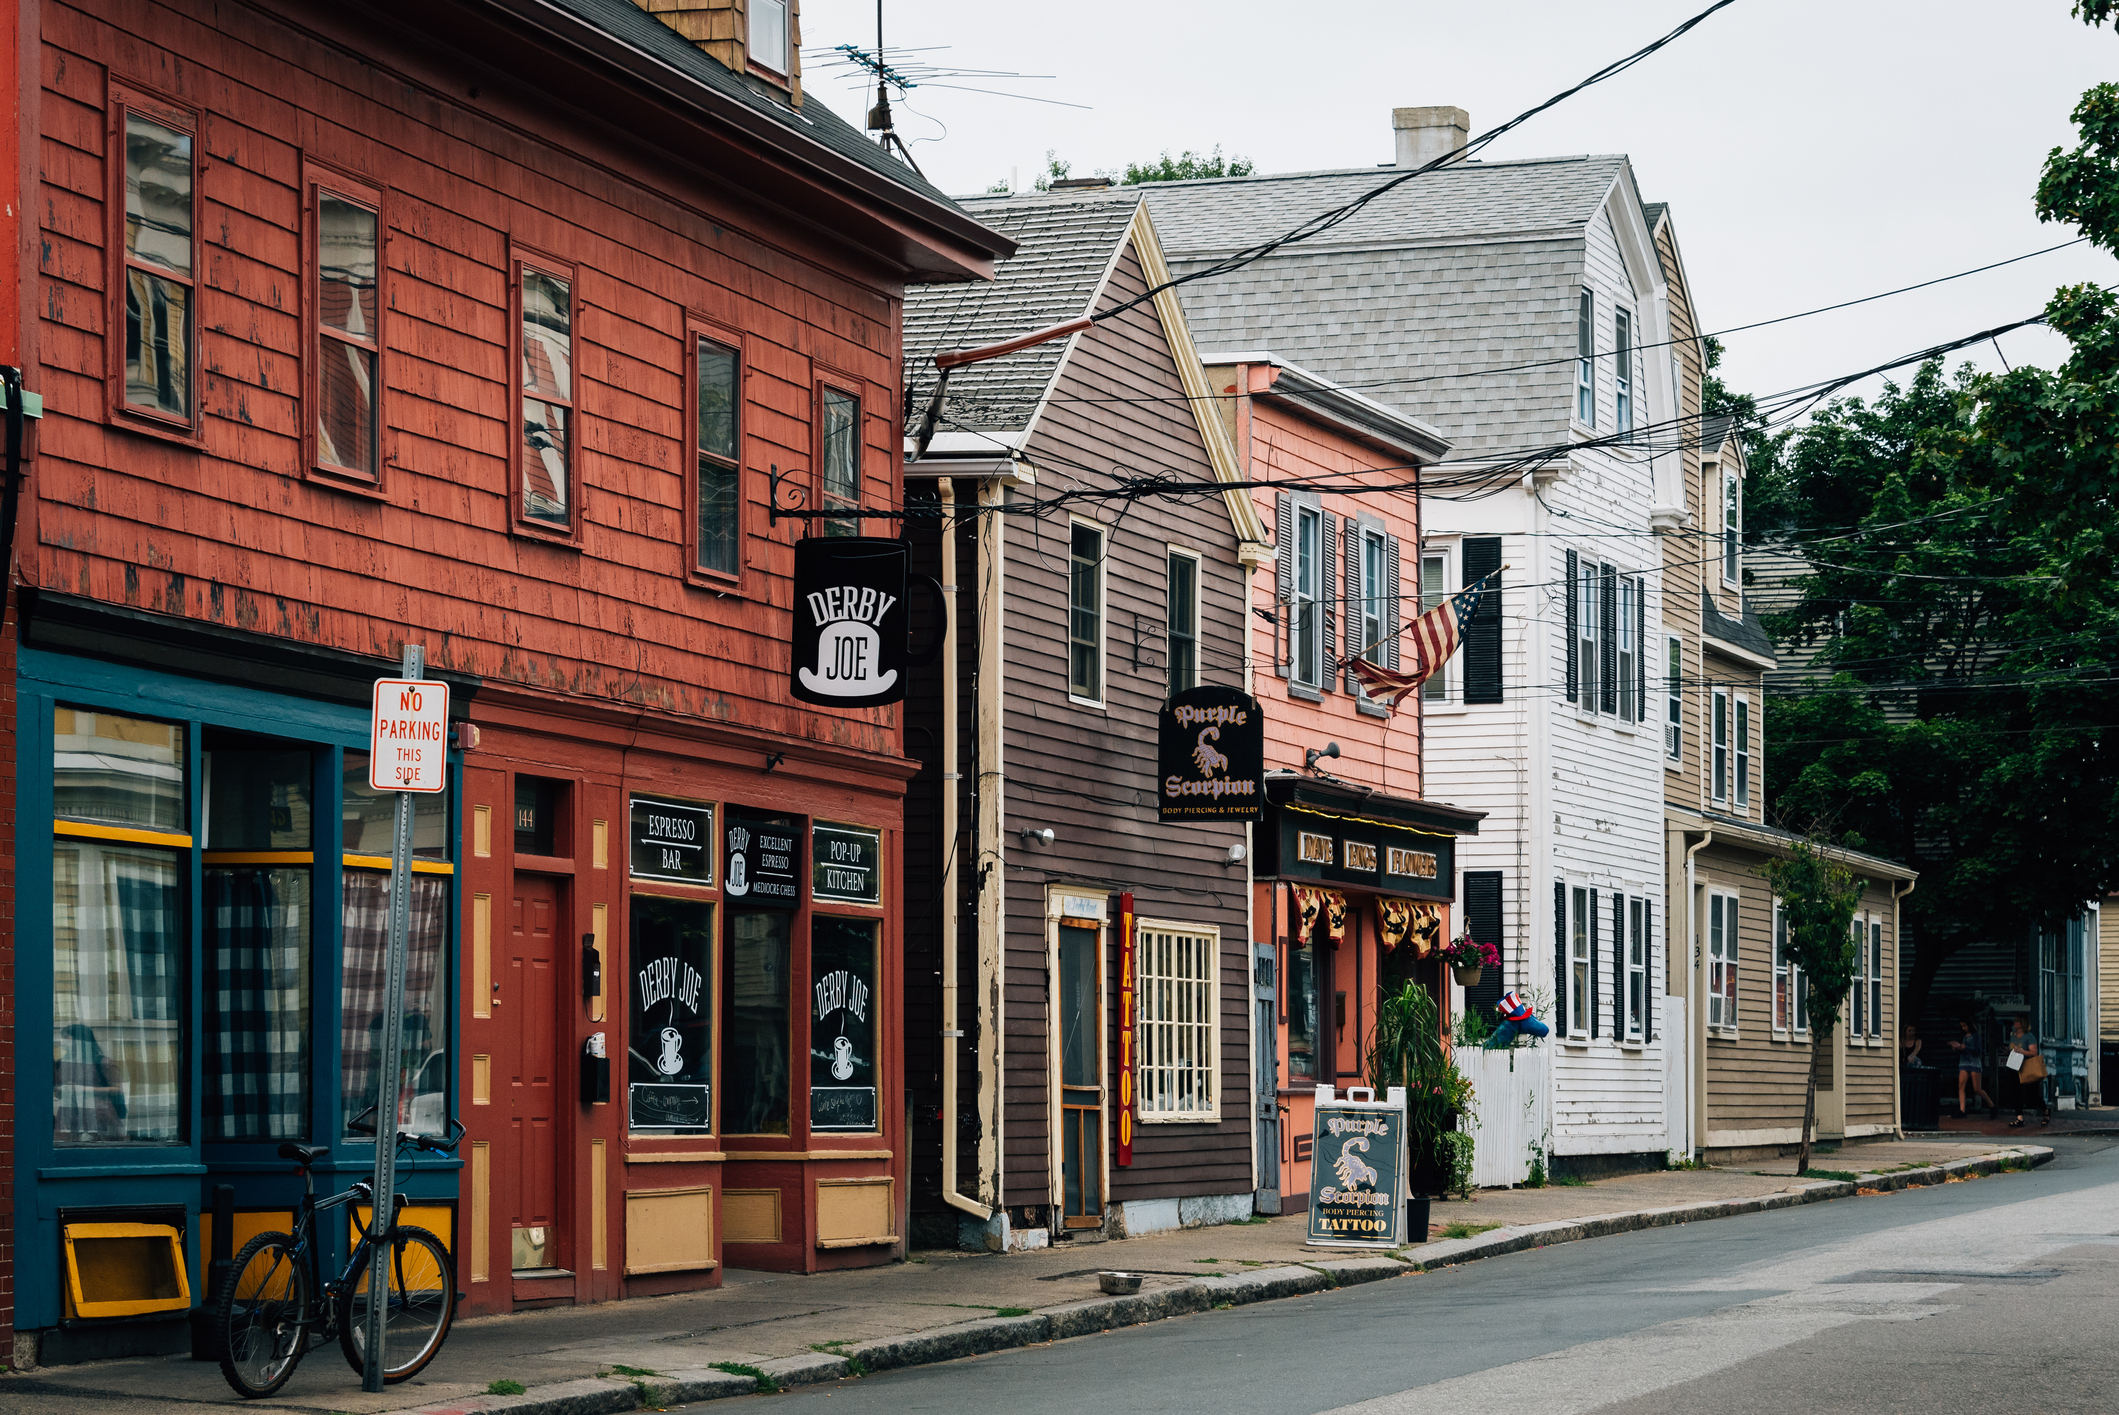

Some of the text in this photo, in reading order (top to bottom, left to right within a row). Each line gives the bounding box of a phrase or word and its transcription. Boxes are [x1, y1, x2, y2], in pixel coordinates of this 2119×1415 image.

[806, 586, 896, 627] DERBY
[826, 636, 868, 680] JOE
[400, 692, 422, 712] NO
[1174, 704, 1247, 729] Purple
[380, 719, 440, 741] PARKING
[397, 748, 422, 762] THIS
[396, 767, 421, 780] SIDE
[1165, 775, 1256, 800] Scorpion
[518, 809, 533, 828] 144
[649, 815, 695, 841] ESPRESSO
[729, 827, 750, 854] DERBY
[760, 835, 792, 852] EXCELLENT
[830, 841, 861, 862] POP-UP
[662, 848, 682, 870] BAR
[762, 854, 789, 869] ESPRESSO
[1392, 849, 1437, 877] FLOWERS
[730, 860, 743, 887] JOE
[827, 869, 864, 891] KITCHEN
[753, 881, 796, 896] MEDIOCRE CHESS
[639, 957, 702, 1015] DERBY JOE
[816, 970, 868, 1023] DERBY JOE
[1121, 912, 1132, 1146] TATTOO
[1327, 1117, 1389, 1138] Purple
[1319, 1186, 1390, 1208] Scorpion
[1346, 1209, 1384, 1217] PIERCING
[1318, 1218, 1387, 1232] TATTOO
